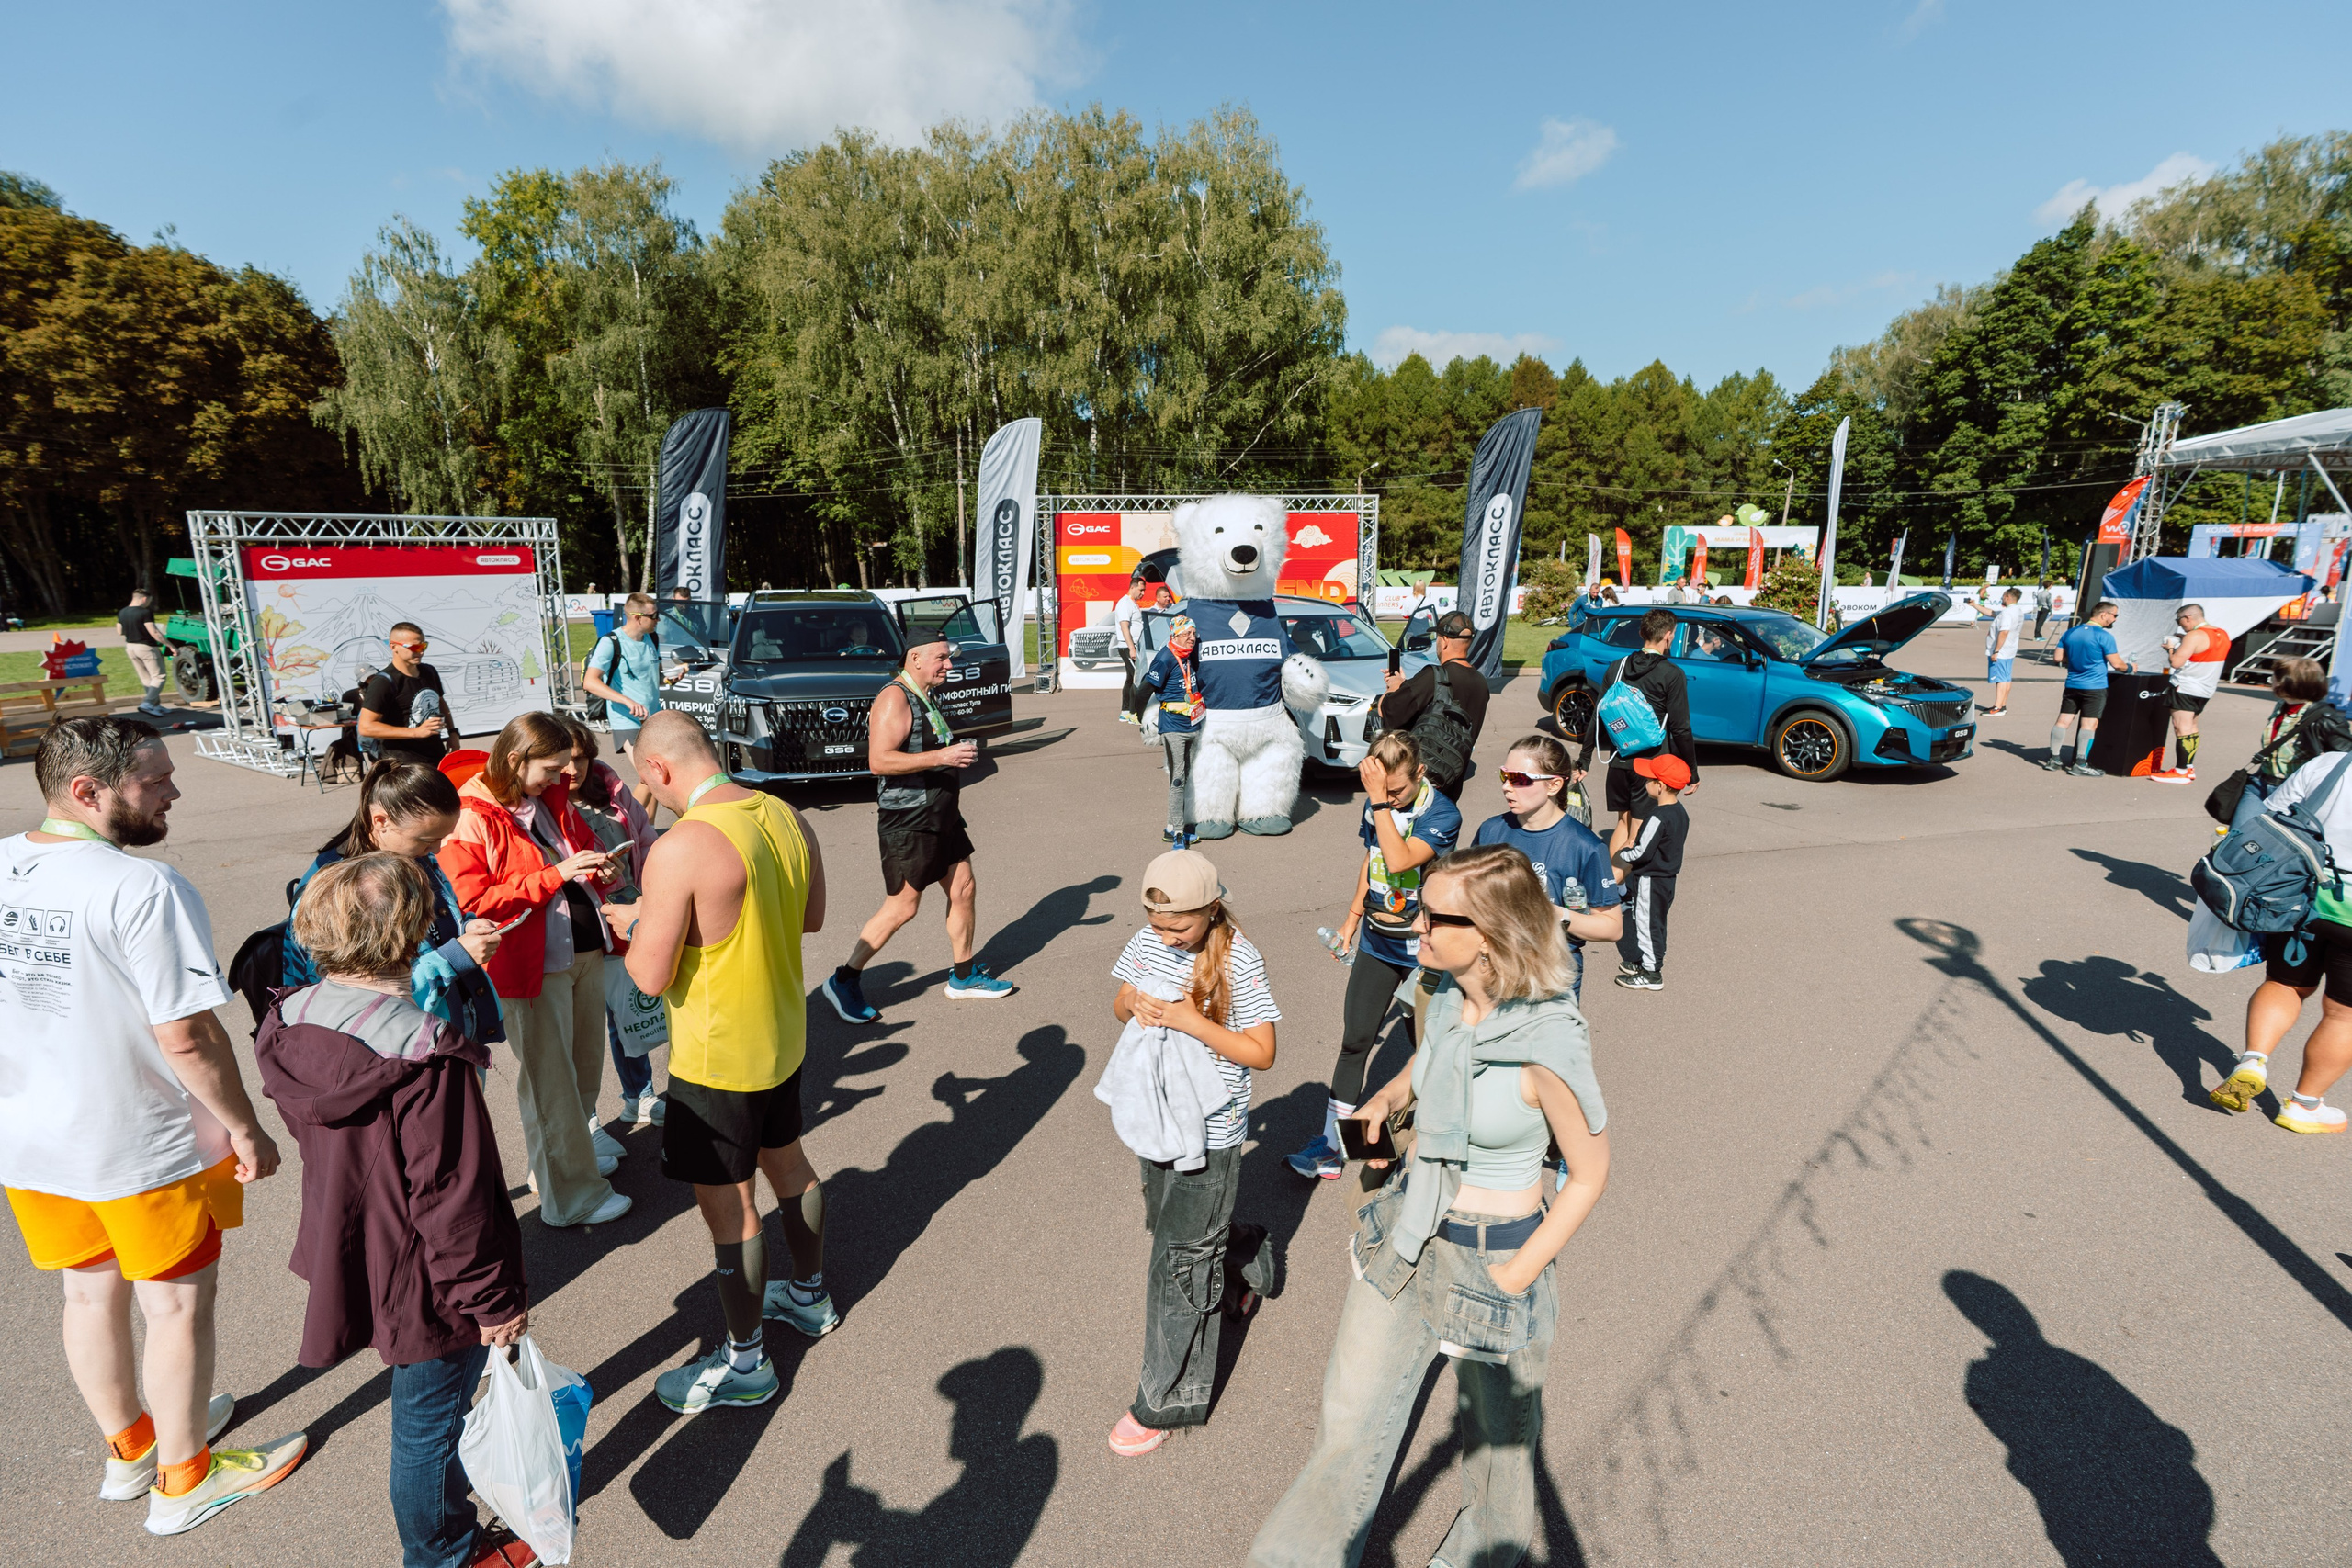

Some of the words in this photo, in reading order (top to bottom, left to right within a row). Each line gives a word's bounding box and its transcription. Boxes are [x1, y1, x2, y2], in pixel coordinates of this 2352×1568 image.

[2252, 525, 2307, 533] ФИНИШЕА
[480, 556, 517, 564] АВТОКЛАСС
[686, 506, 703, 601] ОКЛАСС
[292, 557, 333, 568] GAC
[1480, 506, 1506, 619] АВТОКЛАСС
[1276, 580, 1348, 604] END
[1202, 643, 1278, 657] АВТОКЛАСС
[945, 667, 981, 682] S8
[939, 683, 999, 701] МФОРТНЫЙ
[669, 700, 716, 715] ГИБРИД
[969, 699, 982, 707] Тула
[1955, 729, 1968, 738] GS3
[34, 950, 72, 964] СЕБЕ
[623, 1011, 666, 1034] НЕОЛА
